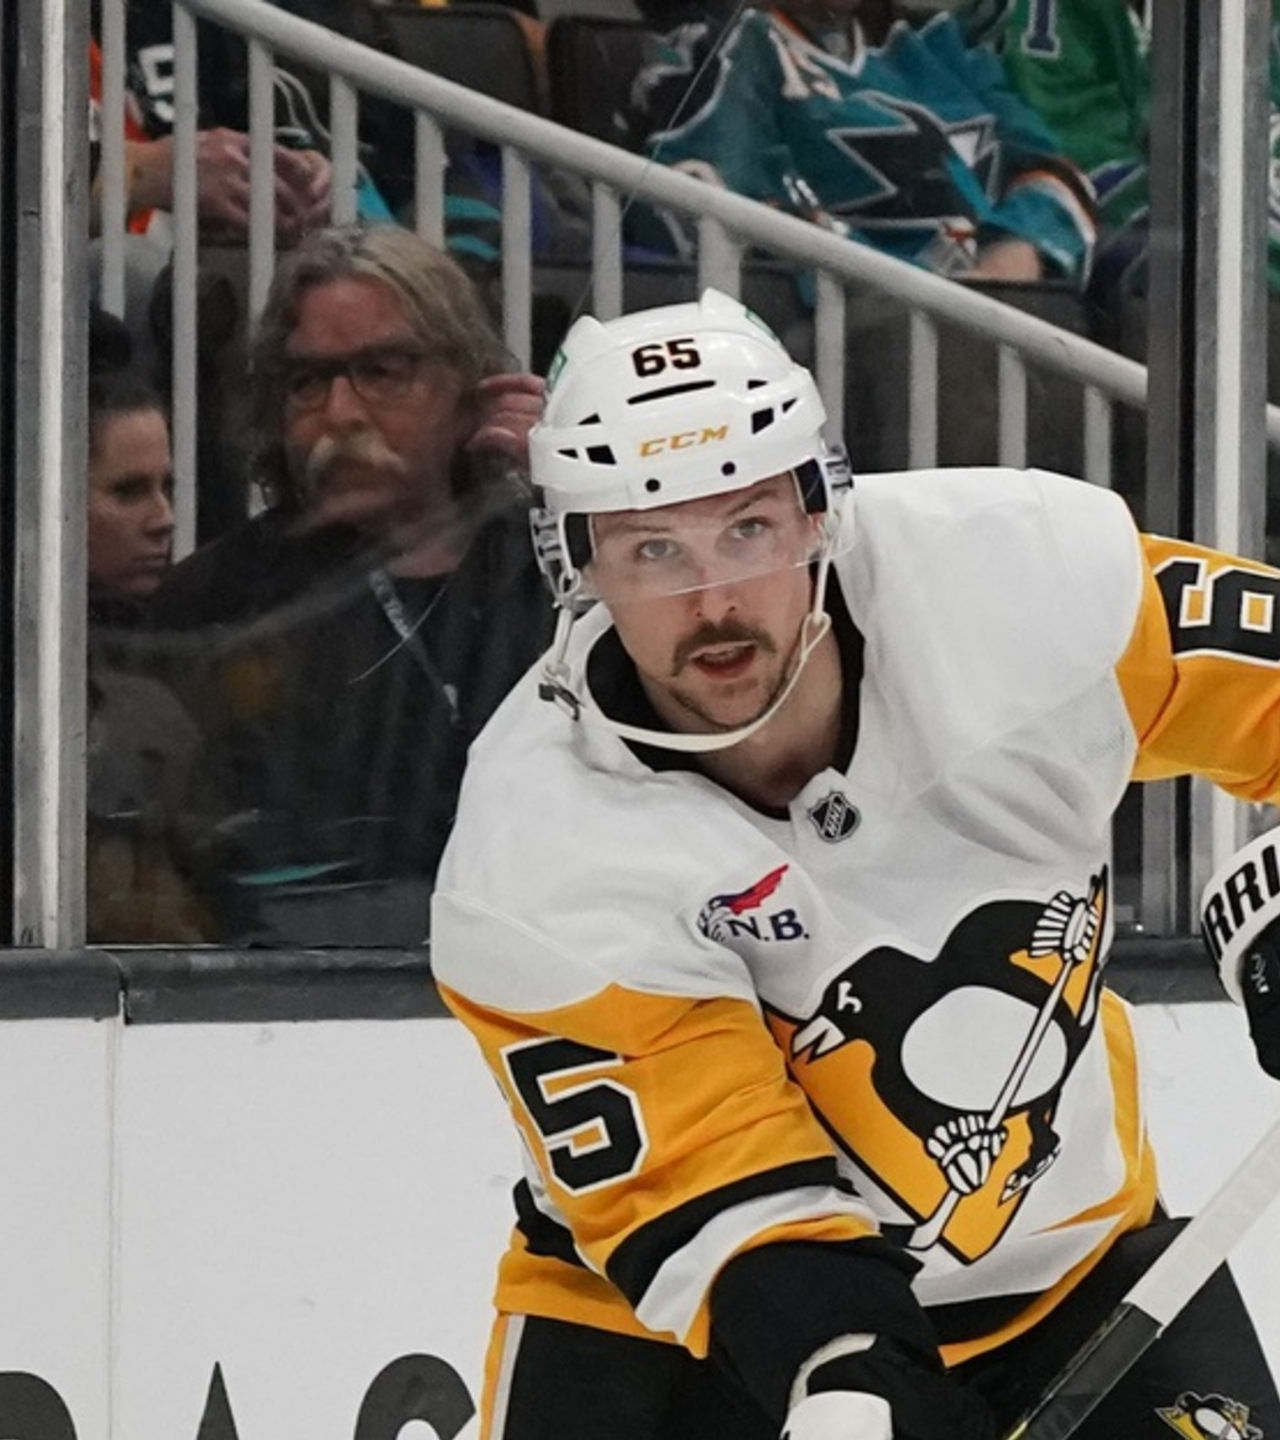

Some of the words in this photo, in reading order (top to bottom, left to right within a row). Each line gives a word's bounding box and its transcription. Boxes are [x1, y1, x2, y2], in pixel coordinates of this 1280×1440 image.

[631, 338, 702, 378] 65
[639, 424, 729, 458] CCM
[499, 1034, 651, 1197] 5
